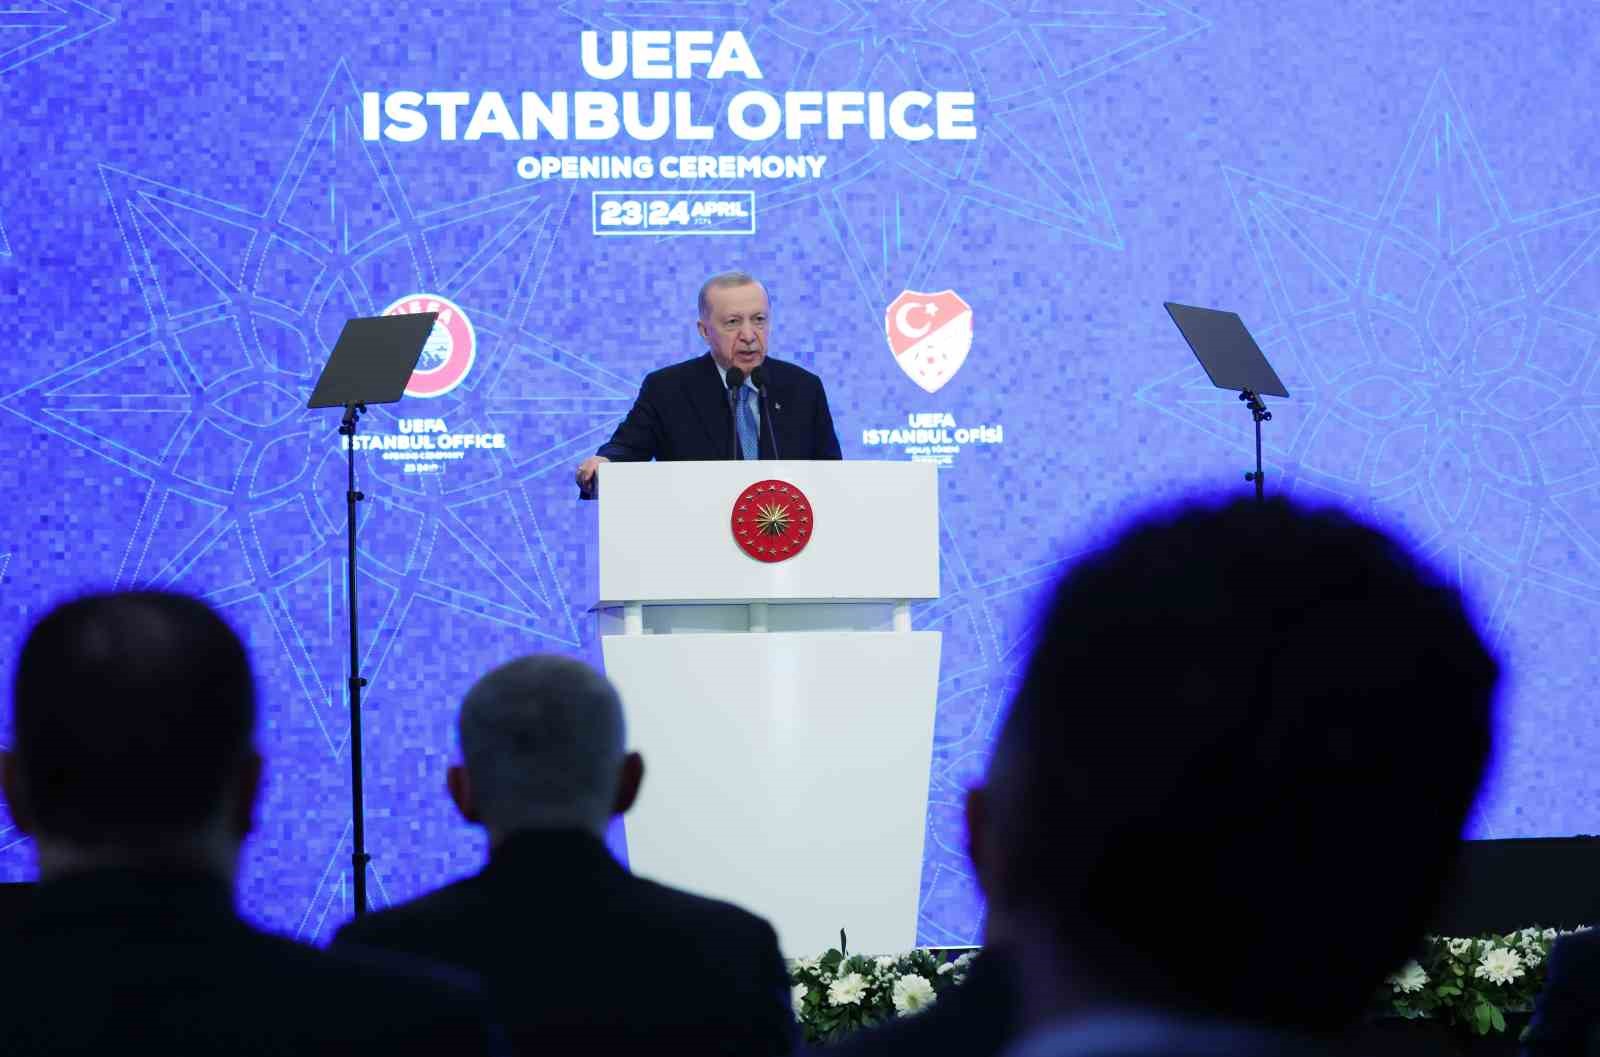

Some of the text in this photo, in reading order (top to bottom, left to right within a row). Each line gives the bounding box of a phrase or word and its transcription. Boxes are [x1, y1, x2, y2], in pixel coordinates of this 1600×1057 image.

[581, 30, 762, 80] UEFA
[363, 91, 977, 142] ISTANBUL OFFICE
[517, 155, 827, 179] OPENING CEREMONY
[691, 201, 748, 217] APRIL
[398, 418, 447, 433] UEFA
[908, 413, 956, 428] UEFA
[437, 433, 506, 449] OFFICE
[862, 429, 952, 445] ISTANBUL
